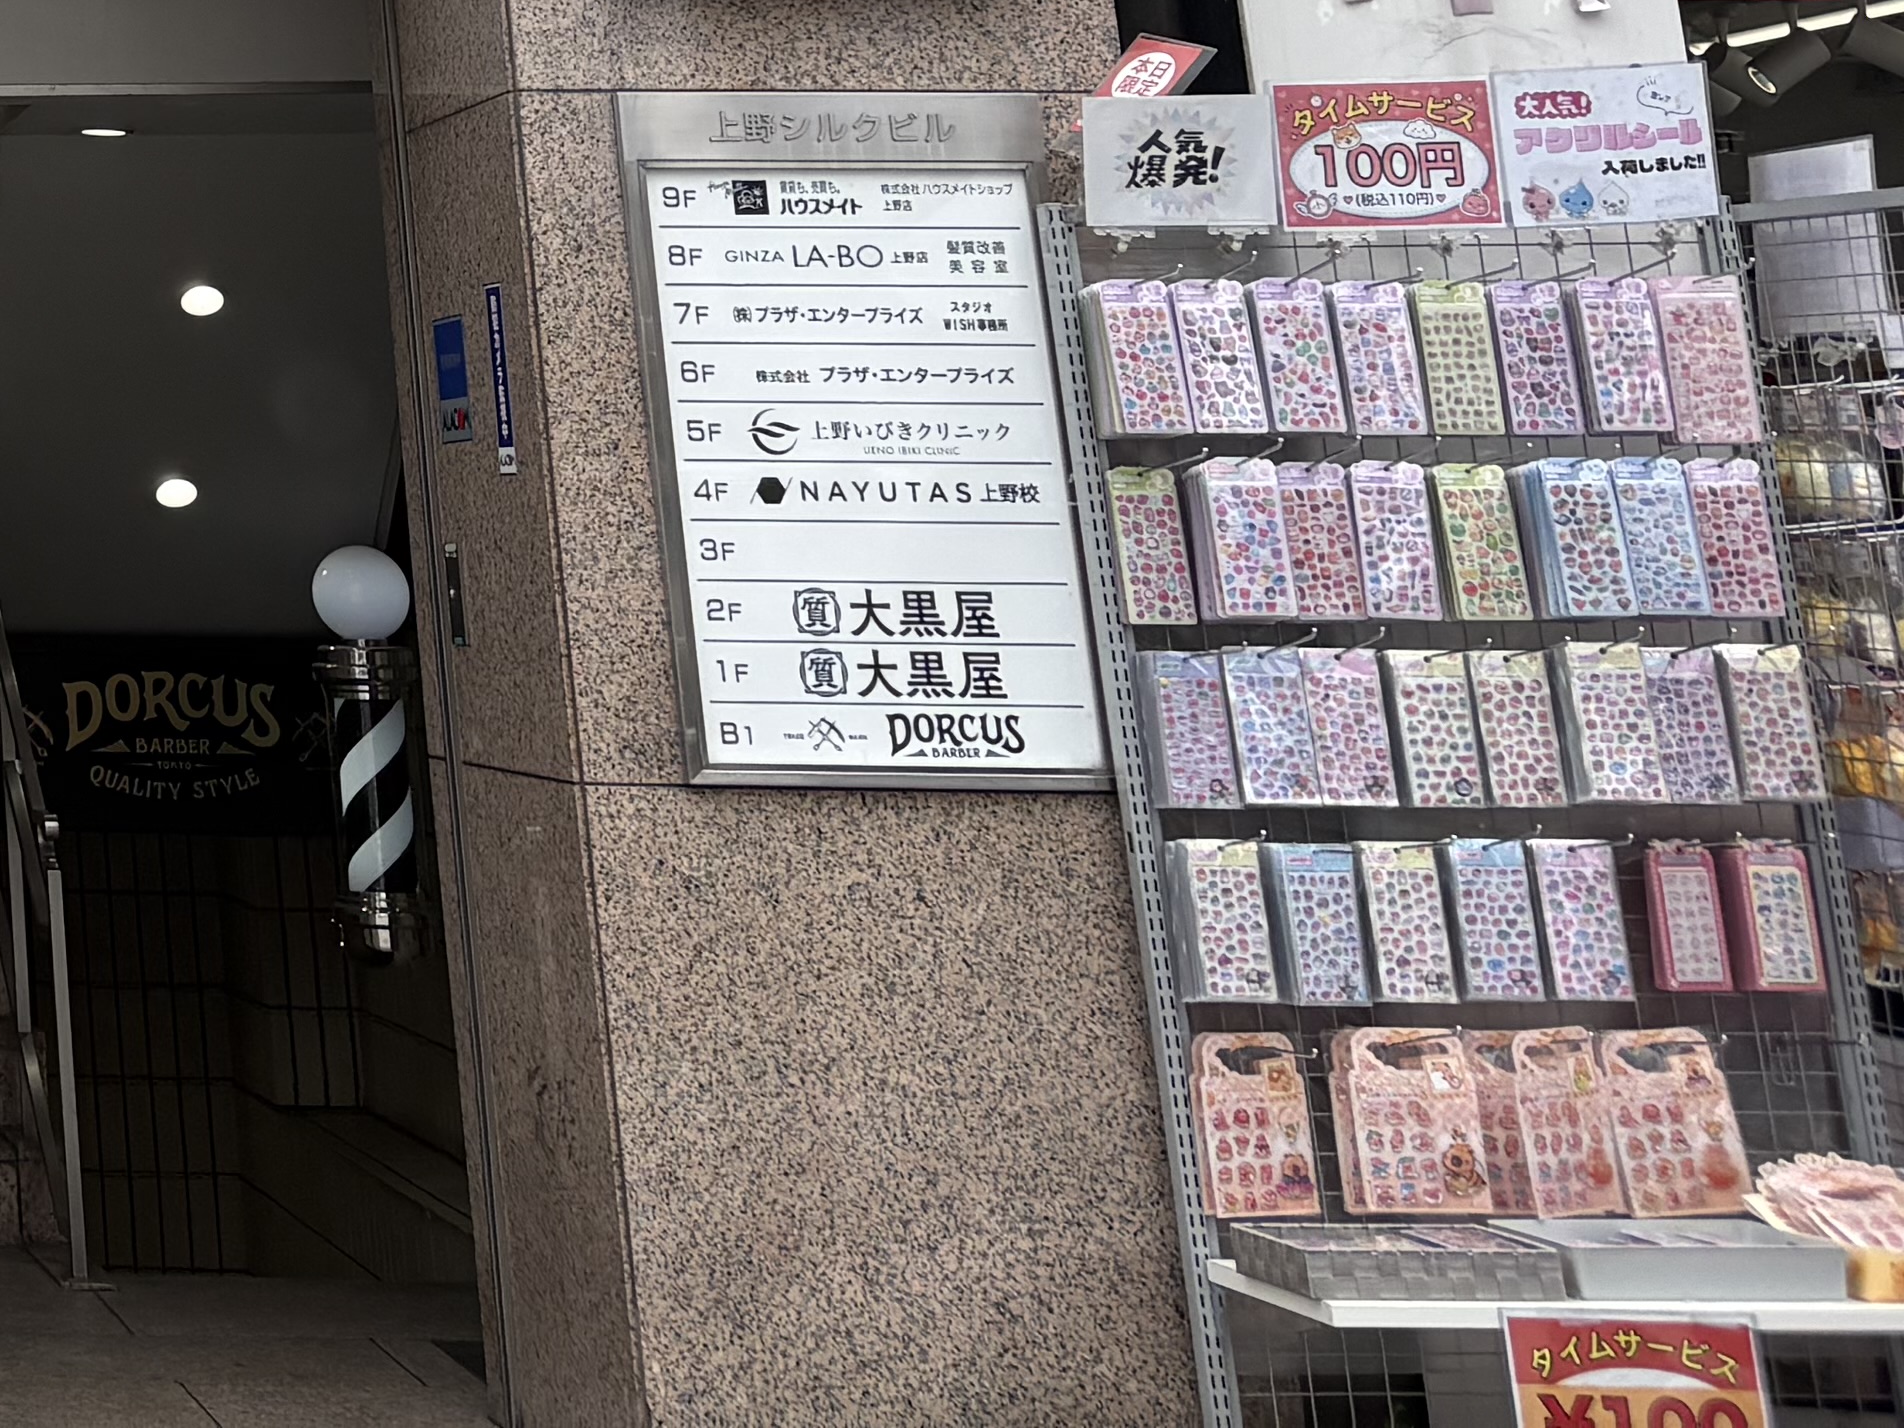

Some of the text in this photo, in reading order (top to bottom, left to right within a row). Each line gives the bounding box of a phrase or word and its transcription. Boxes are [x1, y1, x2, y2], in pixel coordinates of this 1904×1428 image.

[1131, 56, 1173, 80] 本日
[1114, 74, 1160, 97] 限定
[1293, 90, 1476, 137] タイムサービス
[1516, 93, 1589, 118] 大人気!
[708, 110, 958, 144] 上野シルクビル
[1513, 118, 1704, 156] アクリルシール
[1137, 128, 1208, 156] 人気
[1124, 146, 1226, 189] 爆発!
[1314, 140, 1466, 189] 100円
[1601, 152, 1707, 177] 入荷しました!!
[661, 186, 697, 209] 9F
[778, 197, 864, 216] ハウスメイト
[882, 199, 914, 213] 上野店
[1354, 190, 1436, 209] (税込110円)
[667, 244, 703, 267] 8F
[724, 243, 885, 269] GINZA LA-BO
[890, 250, 930, 265] 上野店
[673, 302, 710, 326] 7F
[949, 300, 993, 314] スタジオ
[679, 361, 716, 384] 6F
[755, 366, 1015, 385] 株式会社 プラザ・エンタープライズ
[686, 419, 723, 443] 5F
[810, 419, 1012, 443] 上野いびきクリニック
[693, 479, 729, 503] 4F
[799, 480, 973, 504] NAYUTAS
[979, 481, 1042, 505] 上野校
[699, 538, 736, 562] 3F
[706, 598, 743, 622] 2F
[849, 587, 1001, 638] 大黒屋
[716, 659, 749, 684] 1F
[857, 648, 1009, 700] 大黒屋
[60, 670, 281, 753] DORCUS
[720, 721, 753, 746] B1
[885, 712, 1026, 758] DORCUS
[135, 737, 211, 757] BARBER
[931, 747, 981, 759] BARBER
[89, 764, 261, 801] QUALITY STYLE
[1530, 1329, 1741, 1386] タイムサービス
